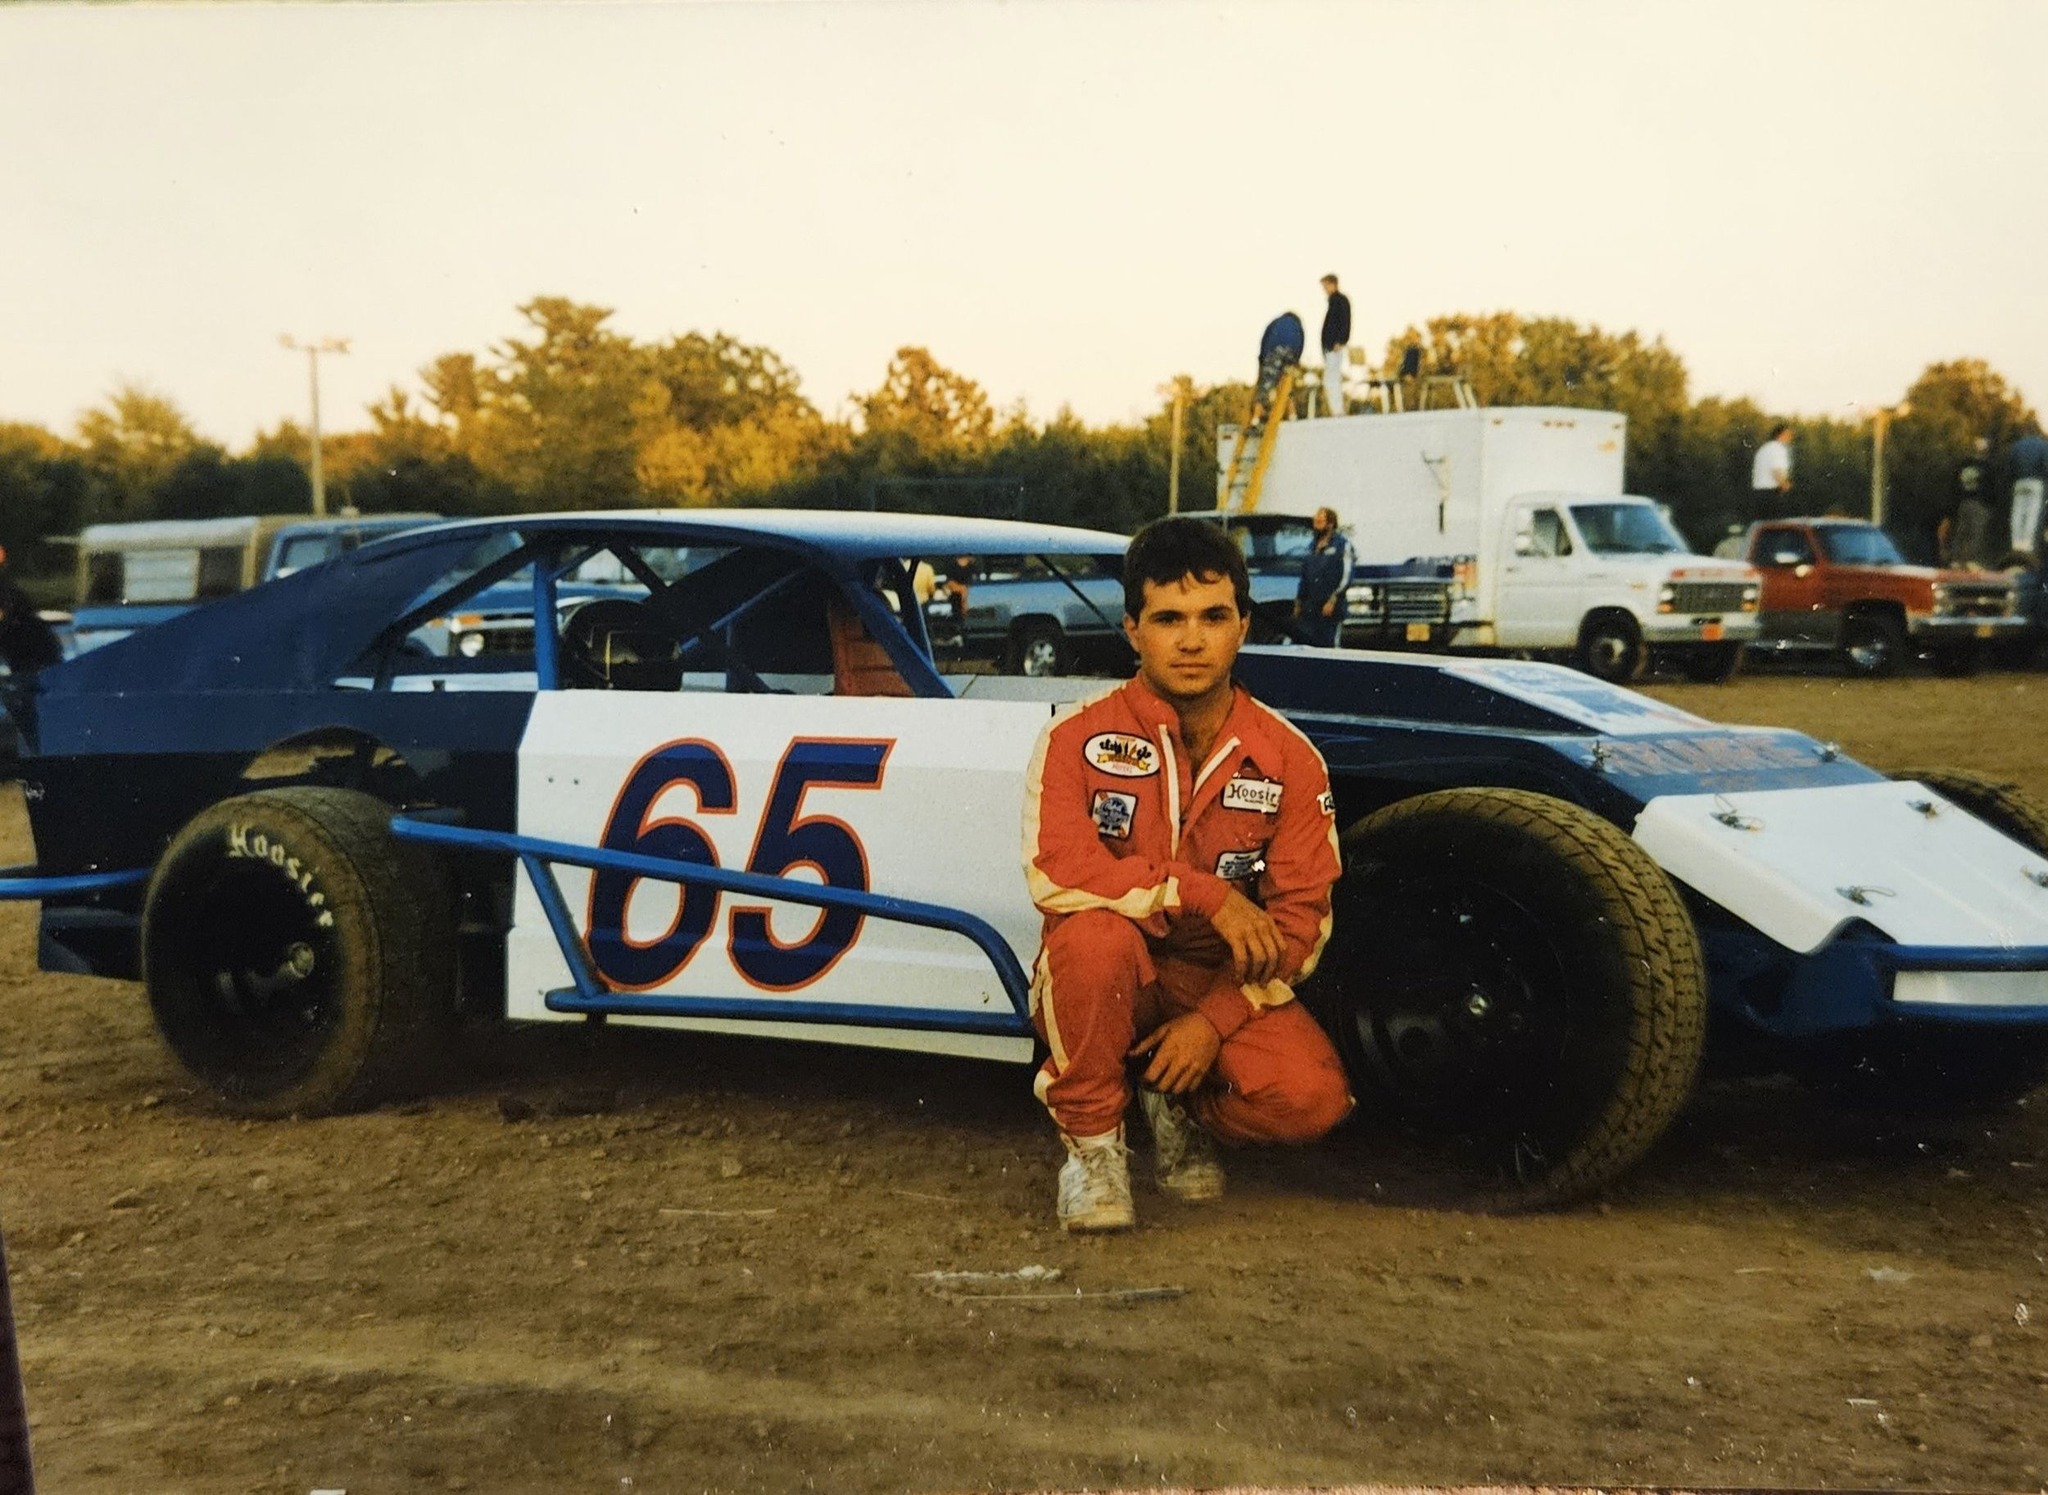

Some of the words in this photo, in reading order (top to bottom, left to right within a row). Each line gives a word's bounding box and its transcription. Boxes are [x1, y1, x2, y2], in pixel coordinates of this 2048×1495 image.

[1226, 783, 1278, 804] Hoosie
[228, 821, 334, 927] Hoosier
[584, 736, 897, 993] 65
